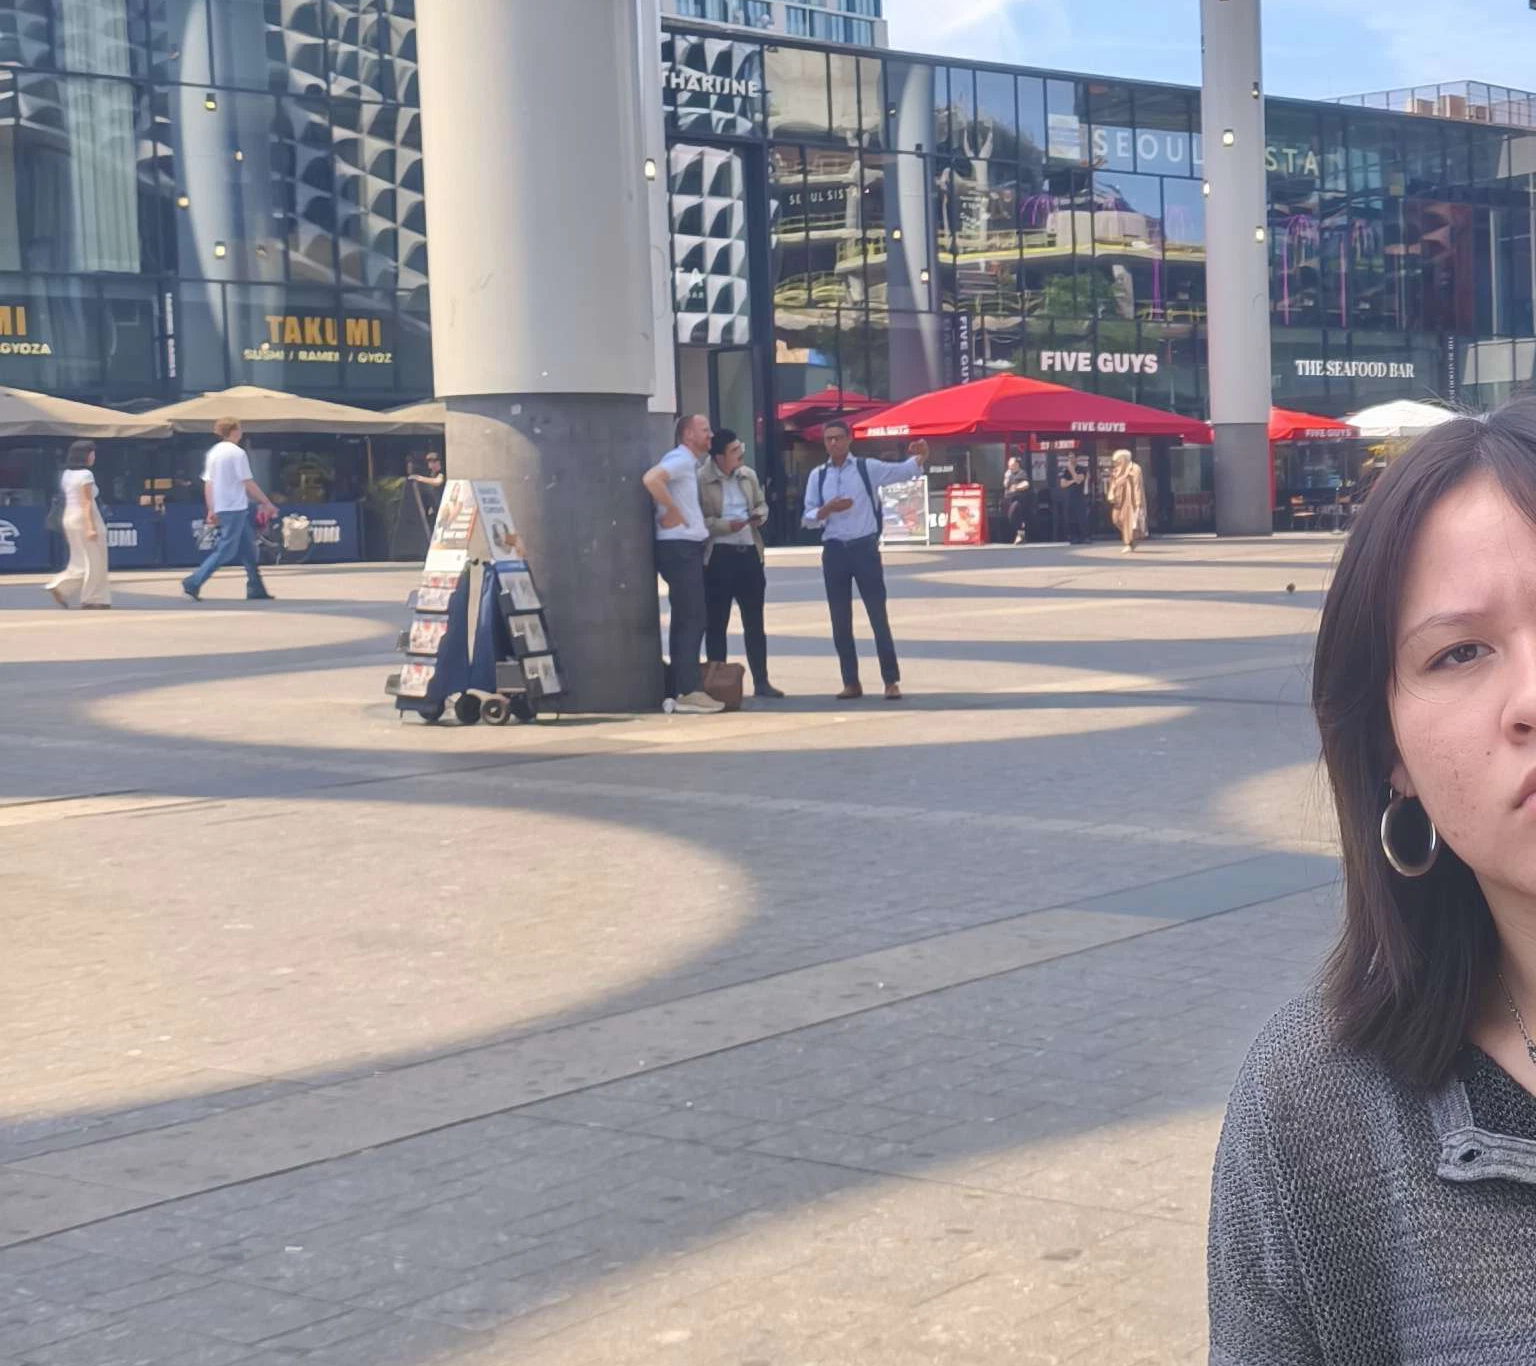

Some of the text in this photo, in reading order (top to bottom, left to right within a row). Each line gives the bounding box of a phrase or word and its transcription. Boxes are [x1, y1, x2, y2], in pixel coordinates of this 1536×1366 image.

[662, 71, 761, 97] THARIJNE
[1093, 129, 1319, 176] SEOUL STA
[789, 192, 823, 205] SEUL
[357, 352, 392, 364] GYOZ
[960, 316, 969, 384] FIVE GUY
[1040, 351, 1158, 374] FIVE GUYS
[1294, 360, 1415, 378] THE SEAFOOD BAR
[1072, 422, 1126, 433] FIVE GUYS
